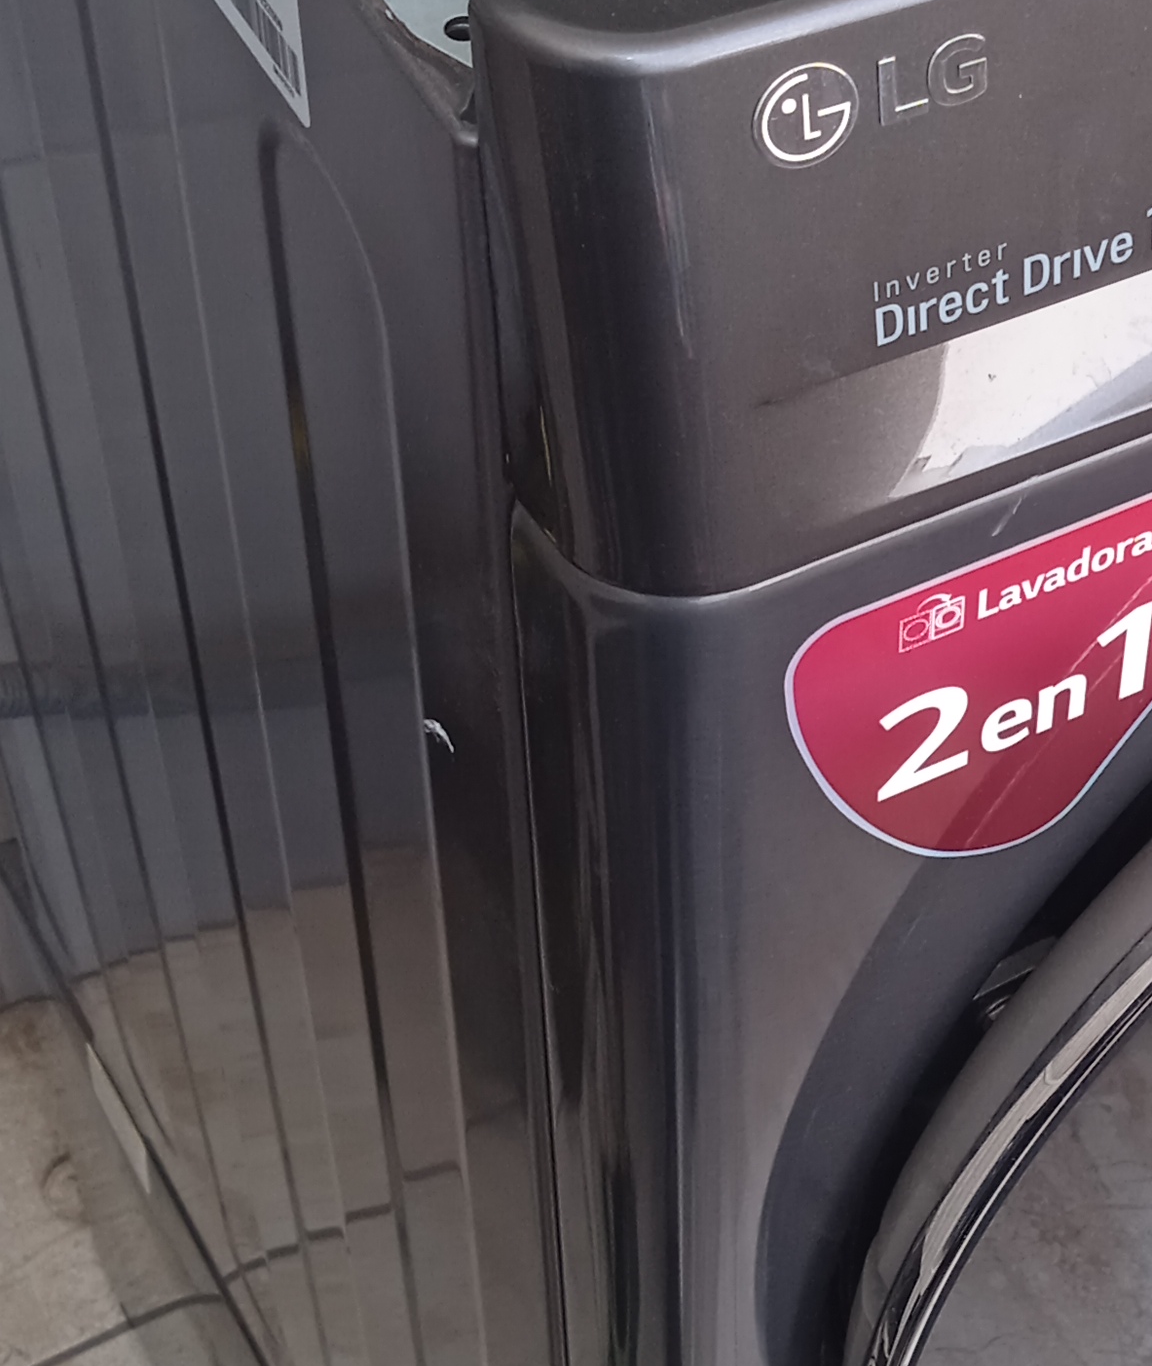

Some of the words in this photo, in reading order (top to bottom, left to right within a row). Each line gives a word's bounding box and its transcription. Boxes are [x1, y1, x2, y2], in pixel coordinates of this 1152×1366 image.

[876, 32, 989, 127] LG
[873, 242, 1008, 302] Inverter
[875, 269, 1010, 347] Direct
[1023, 232, 1134, 296] Drive
[876, 685, 970, 803] 2
[980, 672, 1089, 753] en
